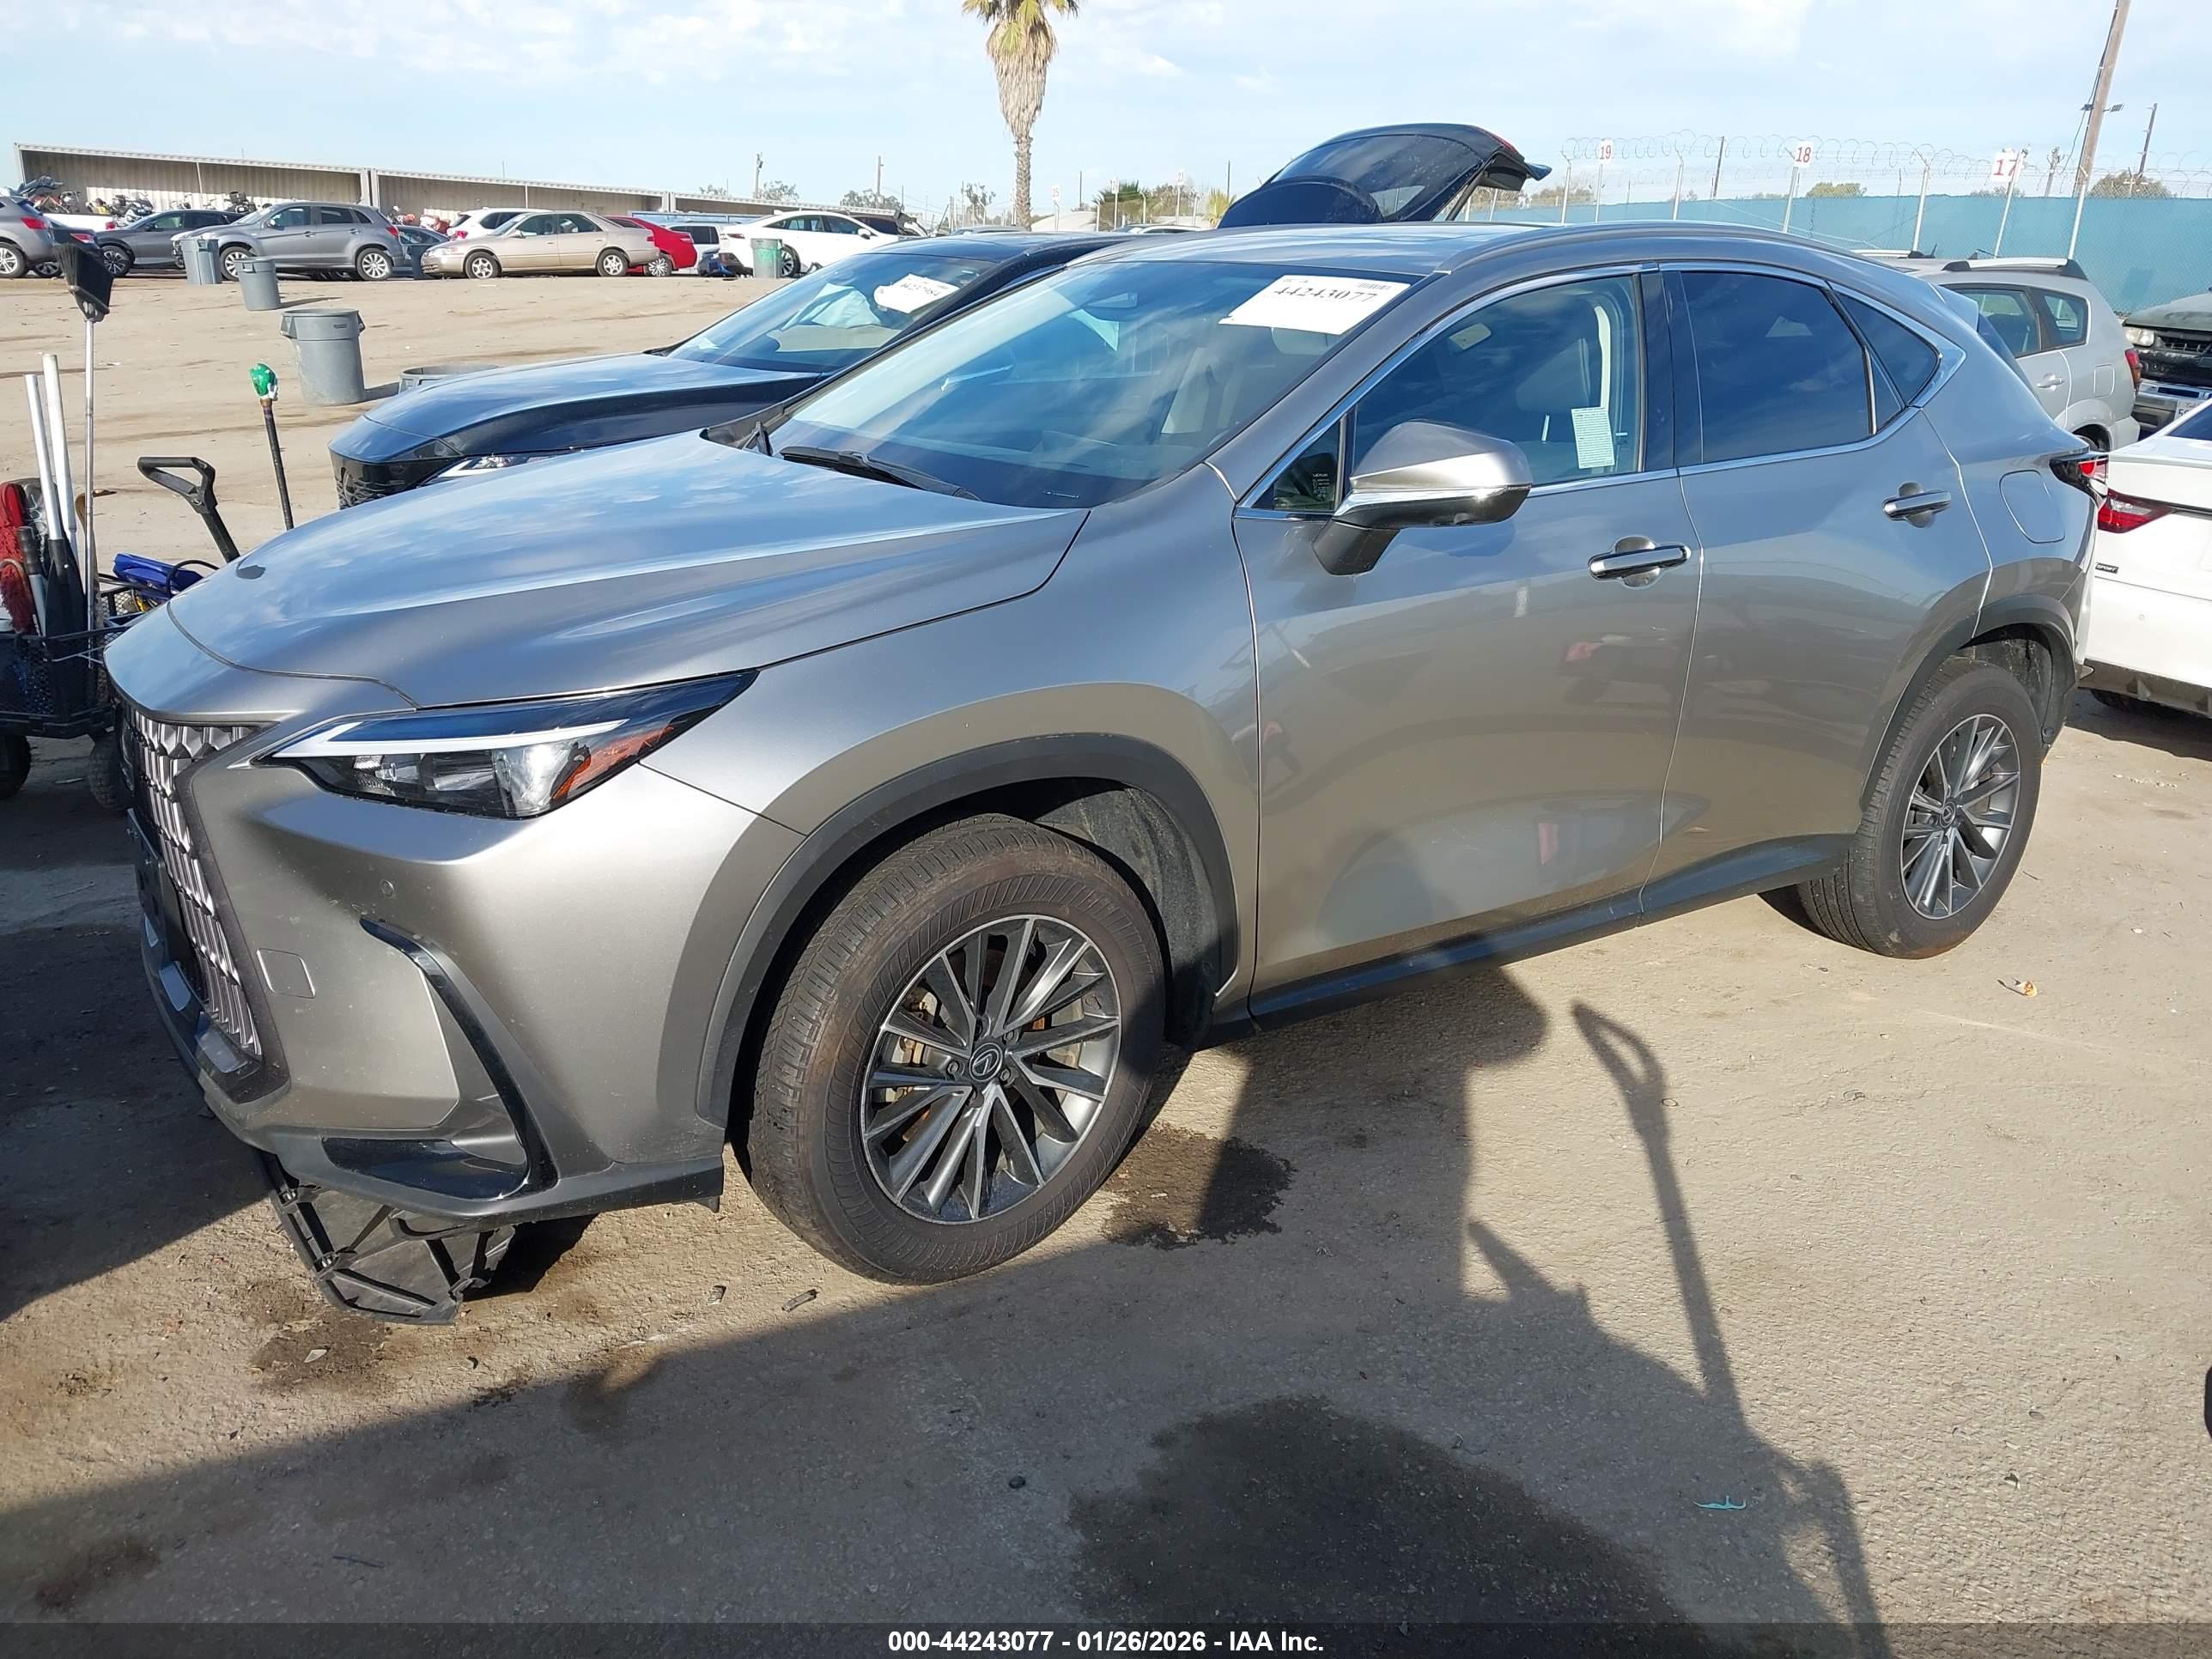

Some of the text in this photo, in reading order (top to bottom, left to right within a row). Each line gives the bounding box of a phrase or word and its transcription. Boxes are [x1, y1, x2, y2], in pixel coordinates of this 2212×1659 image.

[1600, 144, 1611, 160] 19
[1796, 146, 1811, 163] 18
[1992, 158, 2018, 177] 17
